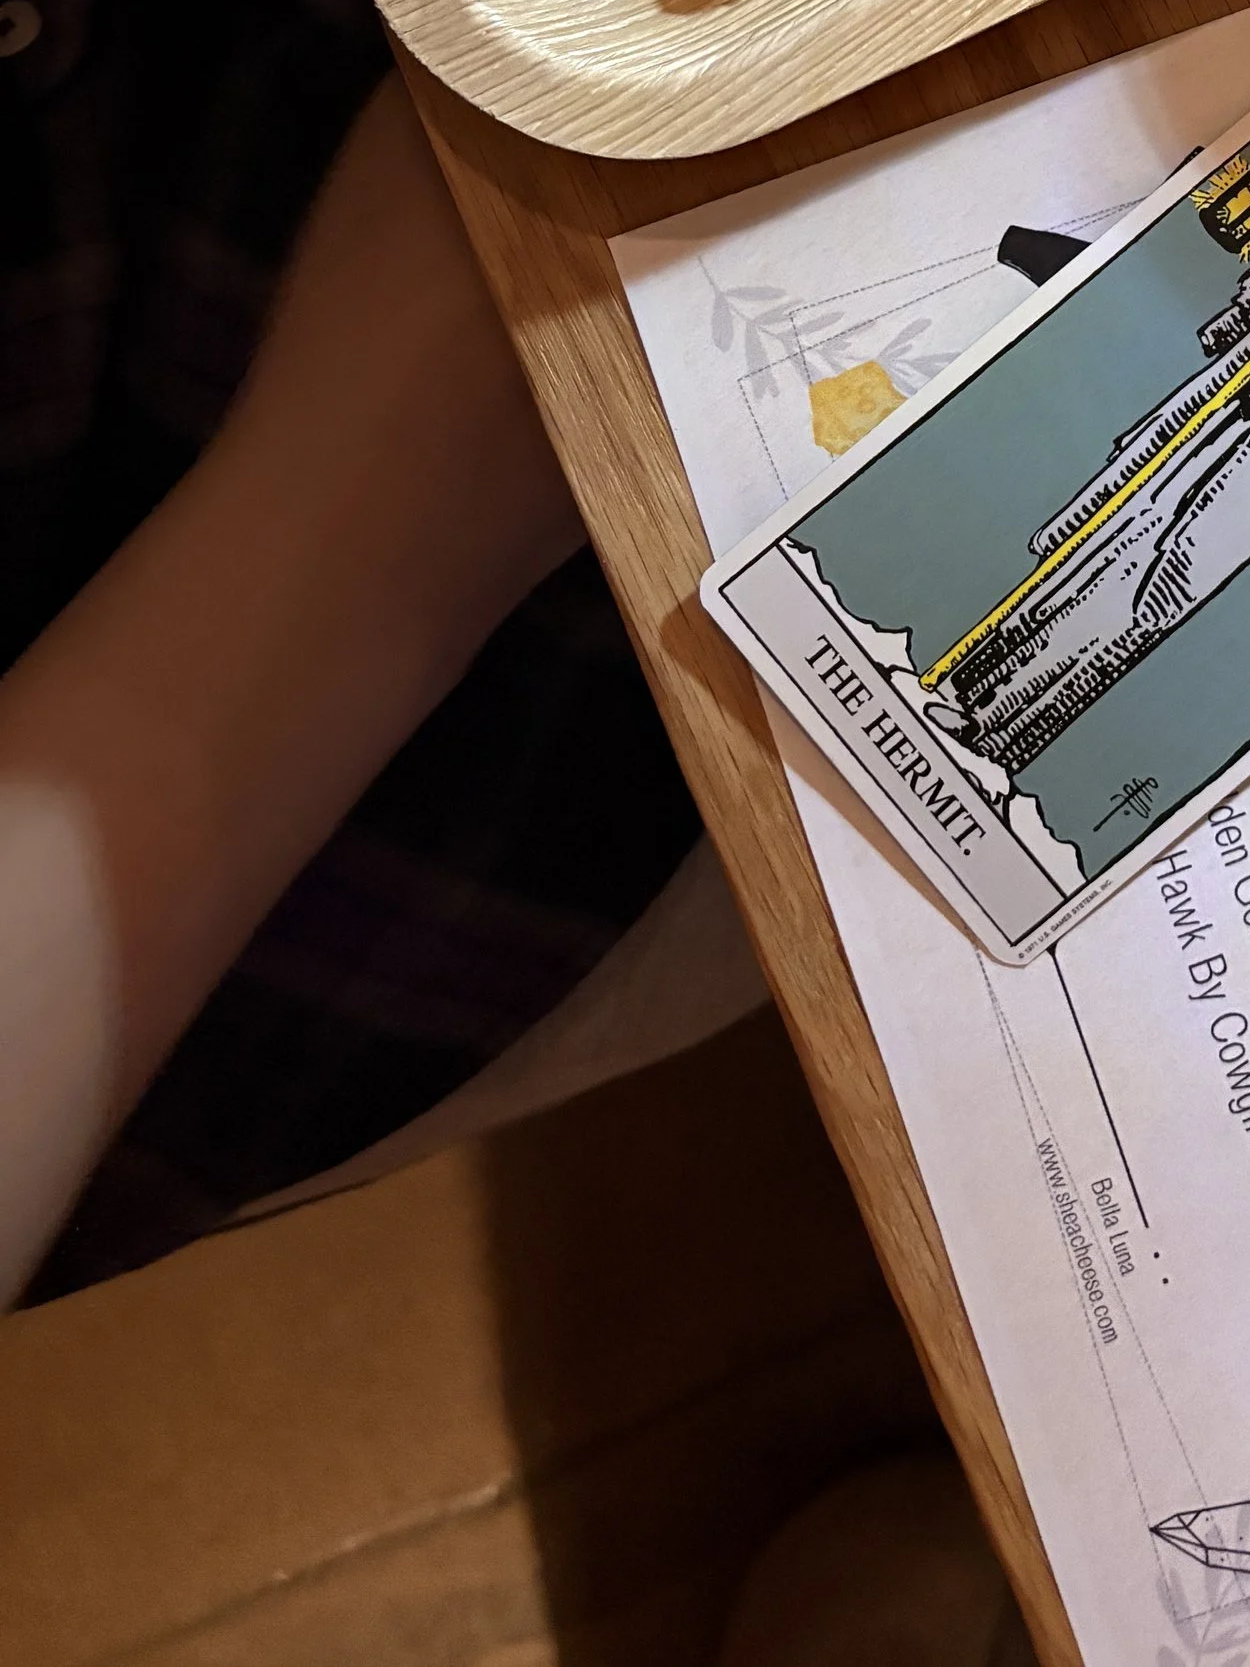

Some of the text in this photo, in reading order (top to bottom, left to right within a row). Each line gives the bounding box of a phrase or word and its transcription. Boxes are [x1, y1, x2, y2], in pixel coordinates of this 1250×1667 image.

[804, 635, 986, 855] THE HERMIT.
[1152, 849, 1213, 950] Hawk
[1188, 953, 1227, 1001] By
[1037, 1138, 1117, 1344] www.sheacheese.com
[1091, 1178, 1134, 1276] Bella Luna
